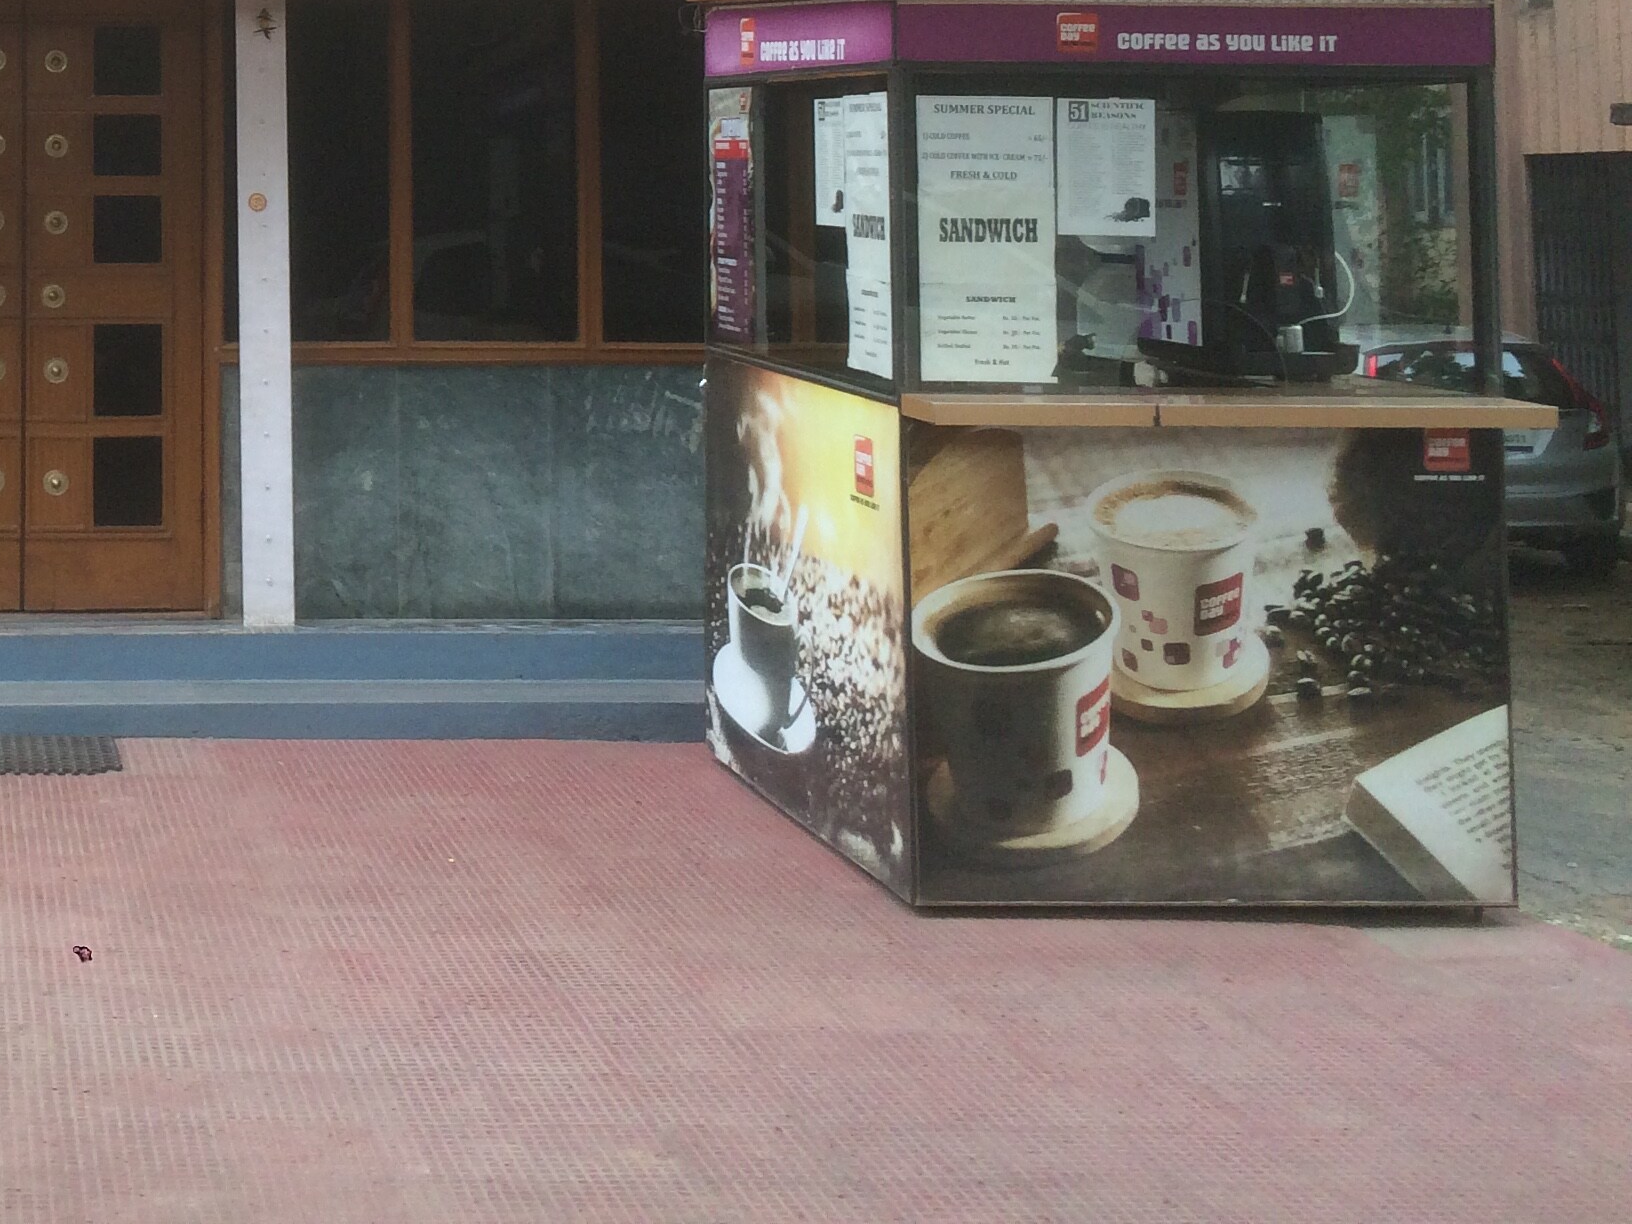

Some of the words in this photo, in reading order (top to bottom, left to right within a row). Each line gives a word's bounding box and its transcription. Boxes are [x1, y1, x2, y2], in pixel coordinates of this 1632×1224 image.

[934, 103, 984, 114] SUMMER
[987, 105, 1036, 116] SPECIAL
[1069, 102, 1088, 121] 51
[950, 170, 980, 180] FRESH
[992, 171, 1018, 181] COLD
[939, 218, 1039, 243] SANDWICH
